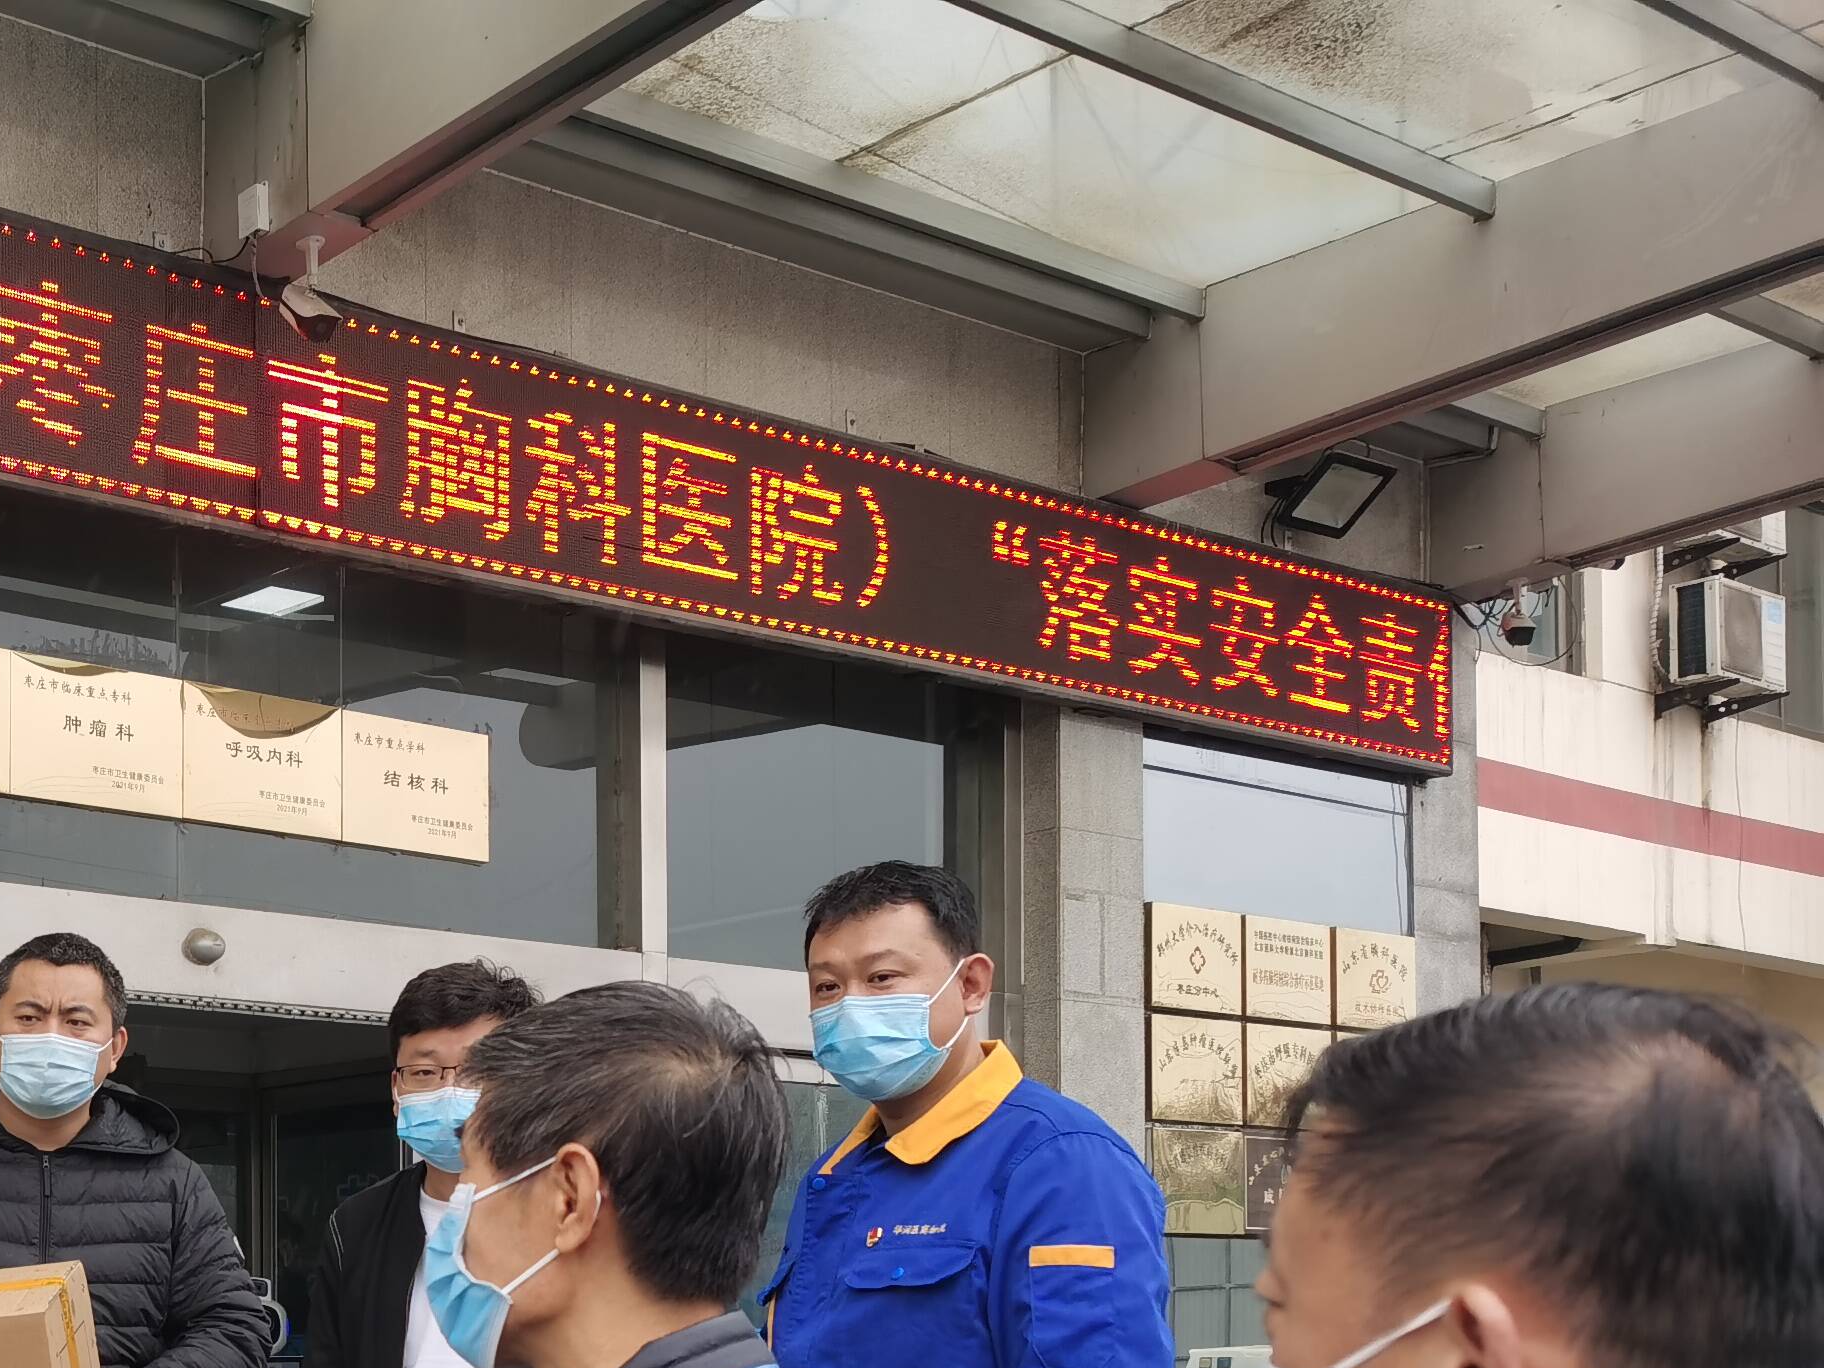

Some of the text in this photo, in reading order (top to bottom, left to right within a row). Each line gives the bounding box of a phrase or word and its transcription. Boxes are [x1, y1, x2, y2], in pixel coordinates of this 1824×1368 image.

[23, 674, 132, 706] 枣庄市临床重点专科
[62, 714, 135, 743] 肿瘤科
[225, 740, 304, 769] 呼吸内科
[353, 731, 425, 756] 枣庄市重点学科
[91, 765, 165, 785] 枣庄市卫生健康委员会
[111, 779, 146, 794] 2021年9月
[383, 769, 449, 795] 结核科
[258, 790, 326, 809] 枣庄市卫生健康委员会
[276, 803, 308, 817] 2021年9月
